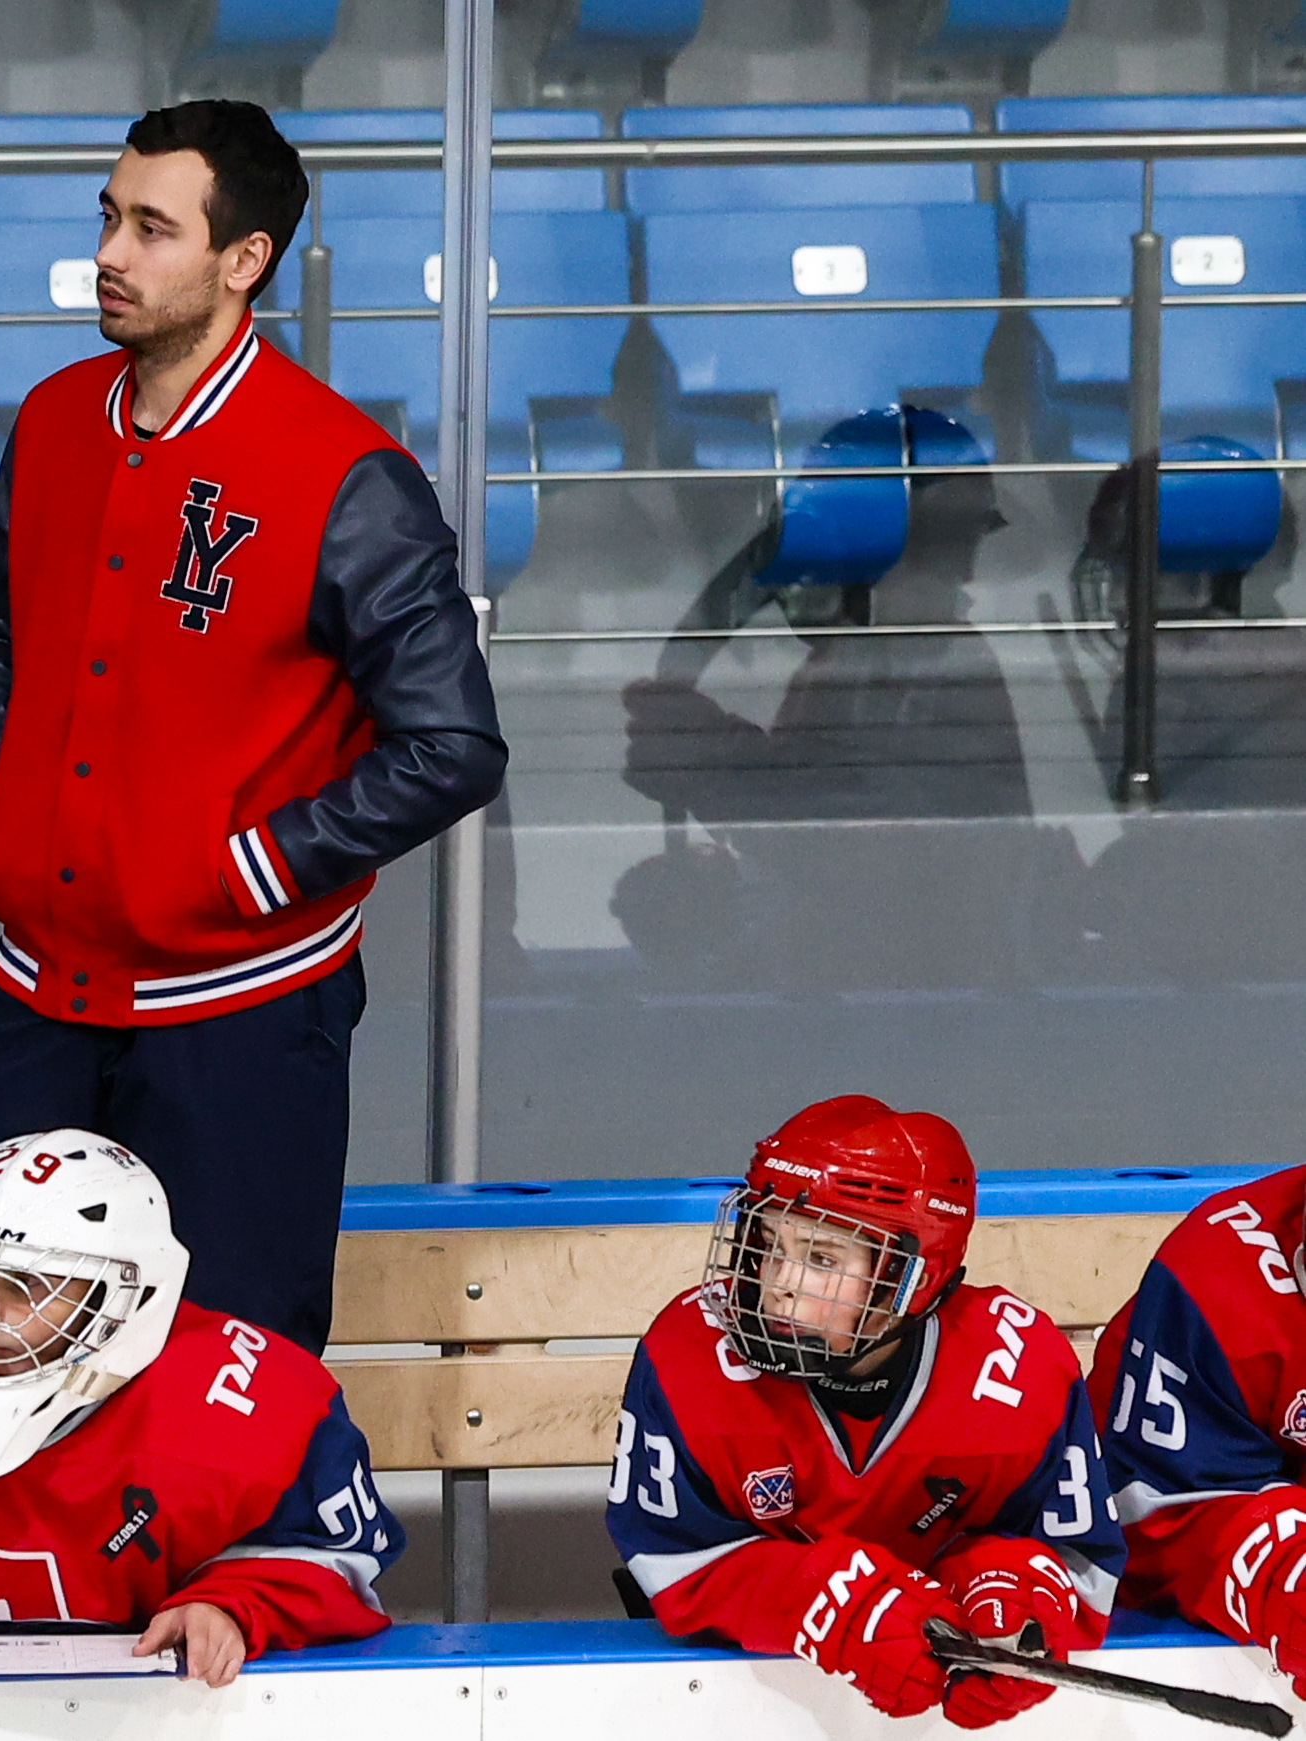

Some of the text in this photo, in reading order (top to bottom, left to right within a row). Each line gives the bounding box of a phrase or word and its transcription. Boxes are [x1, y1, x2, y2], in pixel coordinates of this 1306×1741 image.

[1203, 251, 1214, 271] 2
[81, 275, 93, 294] 5
[764, 1157, 821, 1180] BAUER
[928, 1198, 967, 1217] BAUER
[817, 1376, 889, 1392] BAUER
[1042, 1438, 1114, 1537] 3
[917, 1493, 959, 1530] 07.09.11
[107, 1509, 150, 1553] 07.09.11
[794, 1549, 876, 1665] CCM
